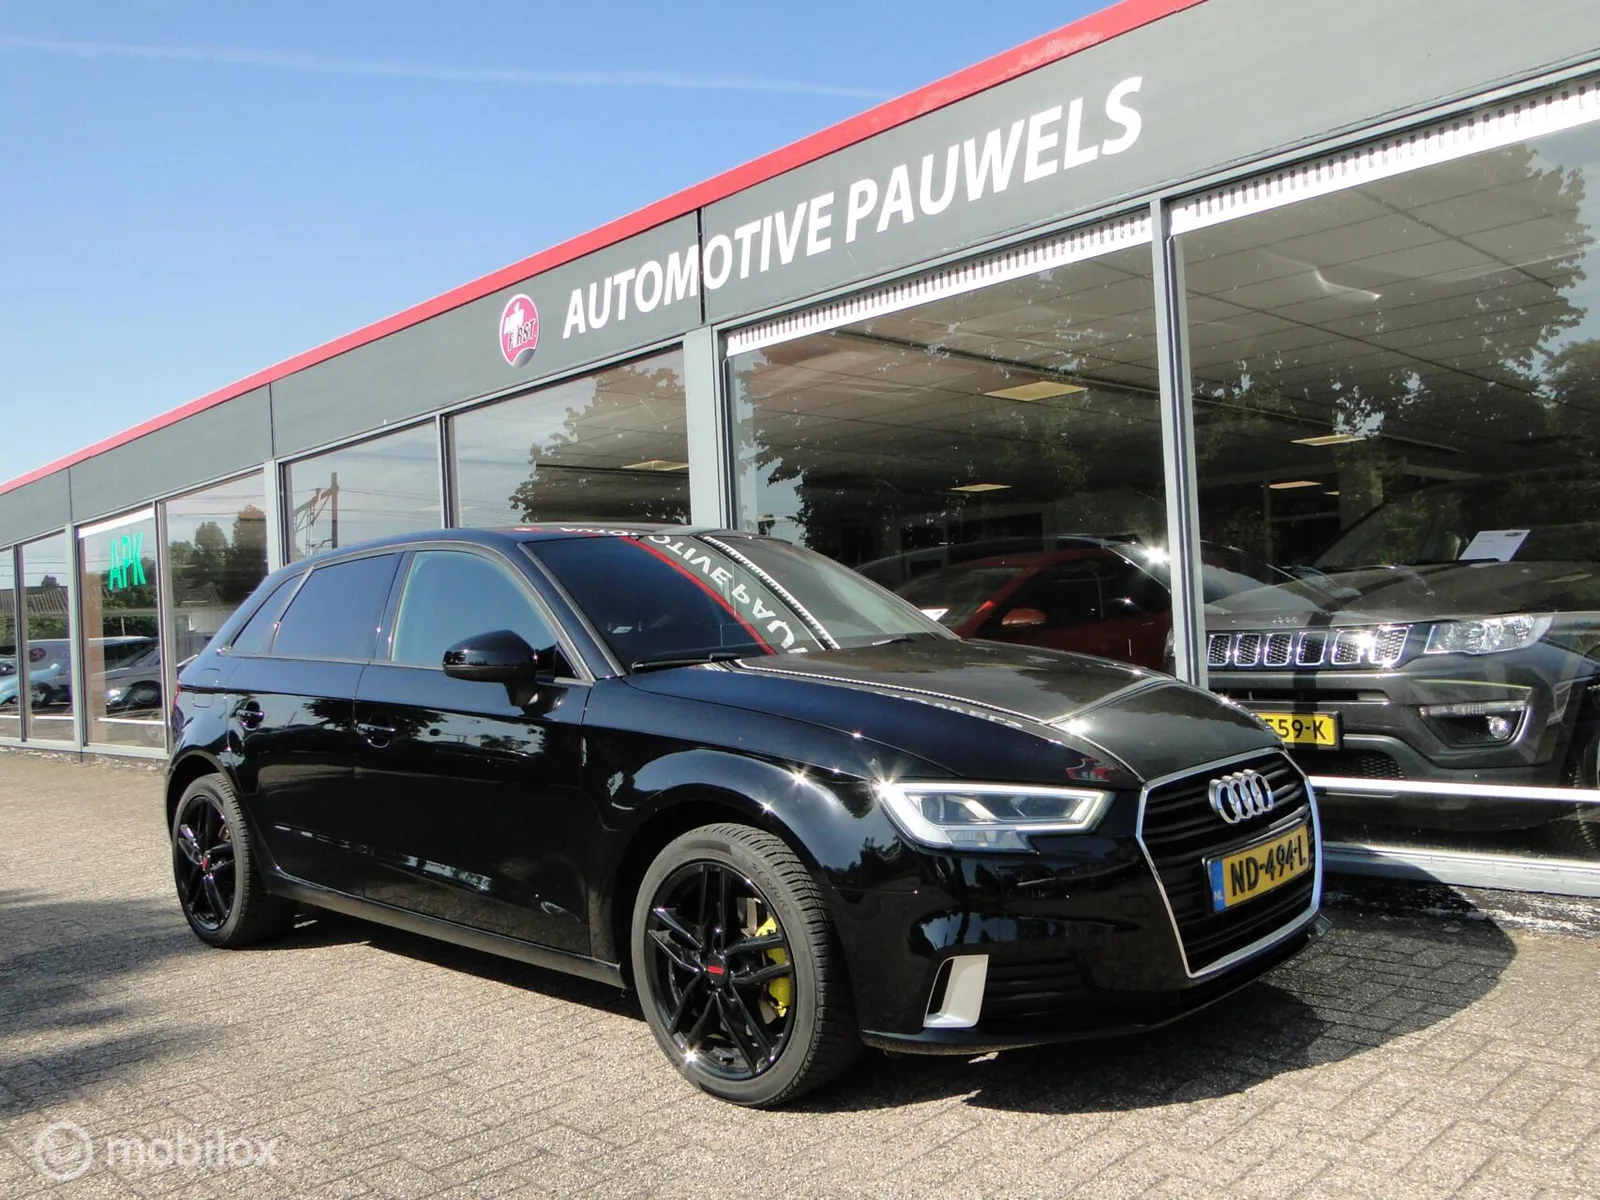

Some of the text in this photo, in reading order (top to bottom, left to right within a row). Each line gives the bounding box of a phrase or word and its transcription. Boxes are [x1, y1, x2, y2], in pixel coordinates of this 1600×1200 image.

[562, 76, 1143, 340] AUTOMOTIVE PAUWELS
[109, 531, 147, 591] APK
[1265, 719, 1327, 740] 59-K
[1230, 835, 1307, 897] ND-494-L
